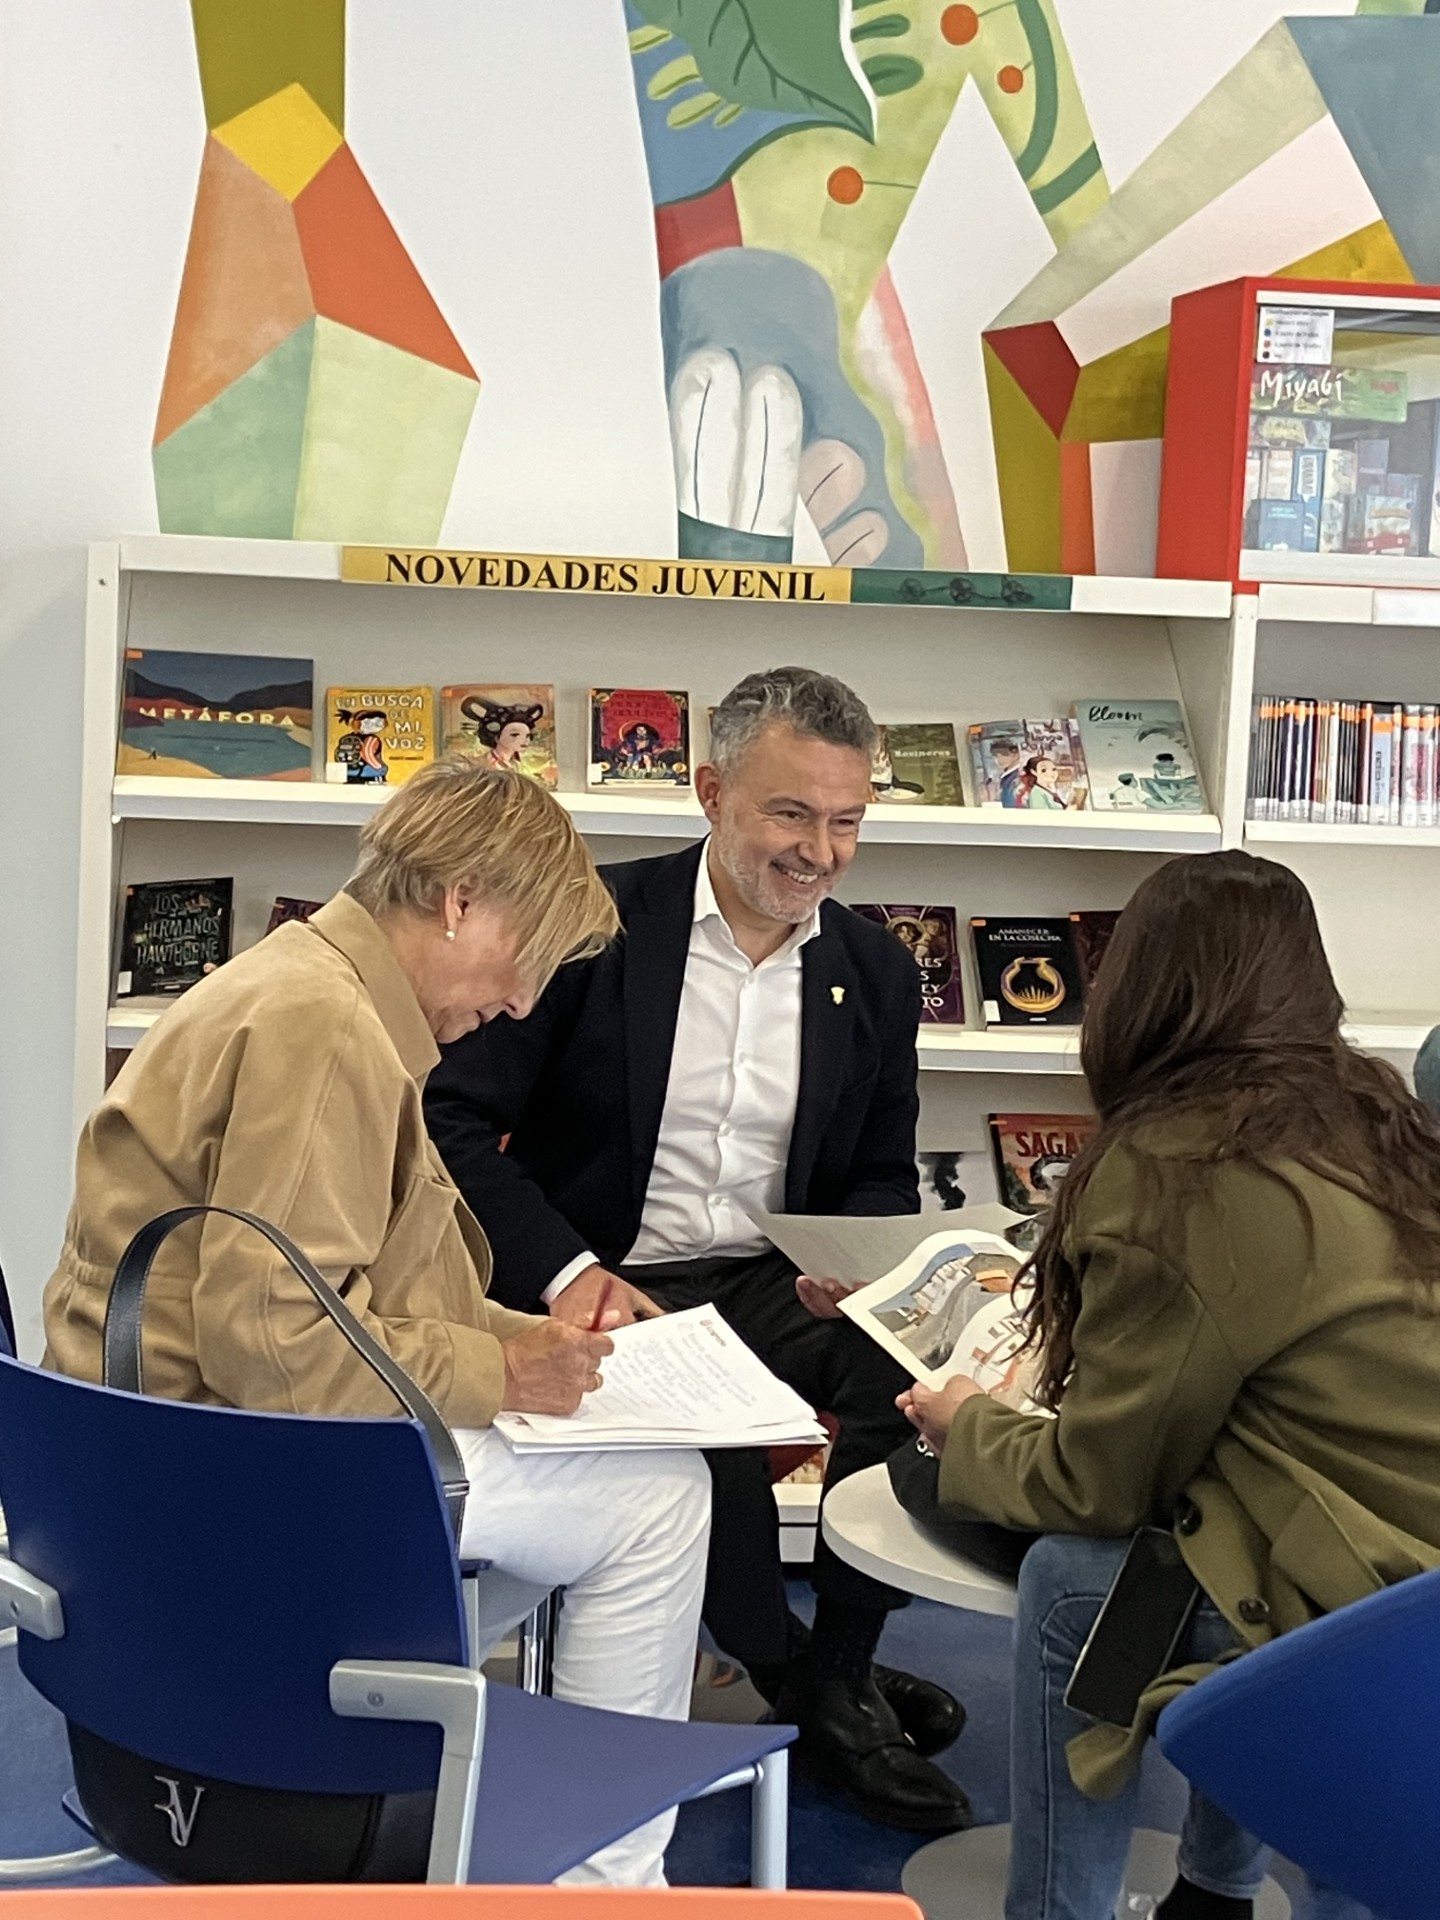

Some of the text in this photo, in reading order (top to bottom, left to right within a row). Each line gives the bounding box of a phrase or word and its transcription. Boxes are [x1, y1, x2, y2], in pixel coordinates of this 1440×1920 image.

[1260, 369, 1343, 409] Miyabi
[385, 553, 826, 602] NOVEDADES JUVENIL
[361, 694, 424, 709] BUSCA
[138, 706, 296, 728] METÁFORA
[1089, 705, 1144, 722] Bloom
[395, 720, 420, 733] MI
[386, 737, 425, 750] VOZ
[154, 893, 180, 915] LOS
[143, 916, 220, 939] HERMANOS
[988, 934, 1002, 942] EN
[998, 928, 1050, 936] AMANECER
[136, 939, 220, 966] HAWTHORNE
[1014, 1131, 1081, 1158] SAGA
